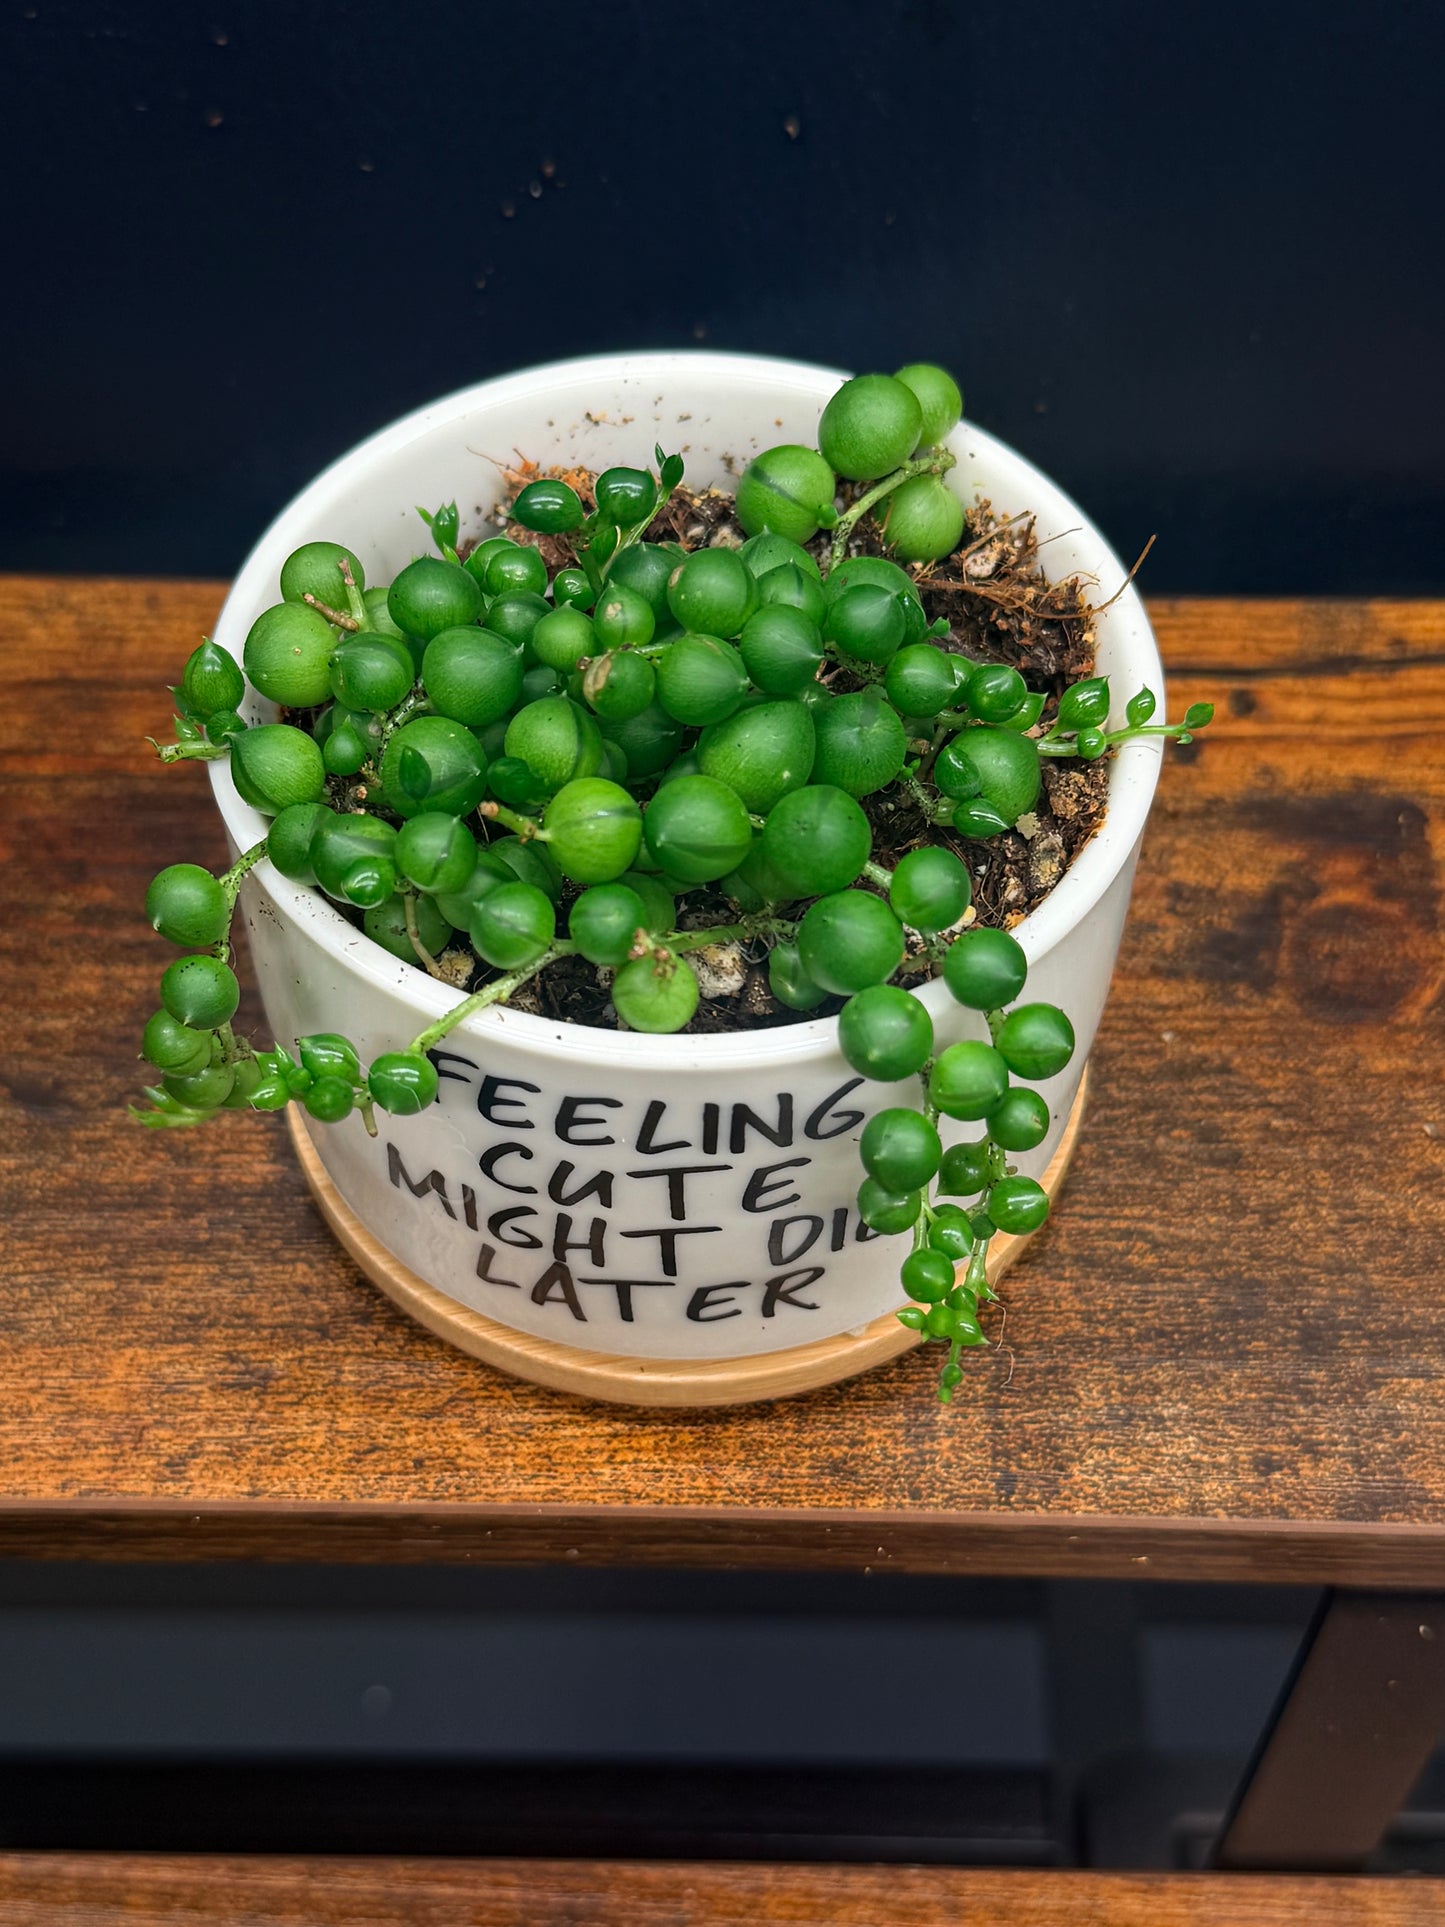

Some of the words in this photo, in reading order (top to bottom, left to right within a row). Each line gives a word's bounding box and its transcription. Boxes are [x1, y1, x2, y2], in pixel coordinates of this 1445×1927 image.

[427, 1049, 866, 1155] FEELING
[386, 1142, 723, 1277] MIGHT
[478, 1142, 812, 1221] CUTE
[475, 1243, 826, 1323] LATER
